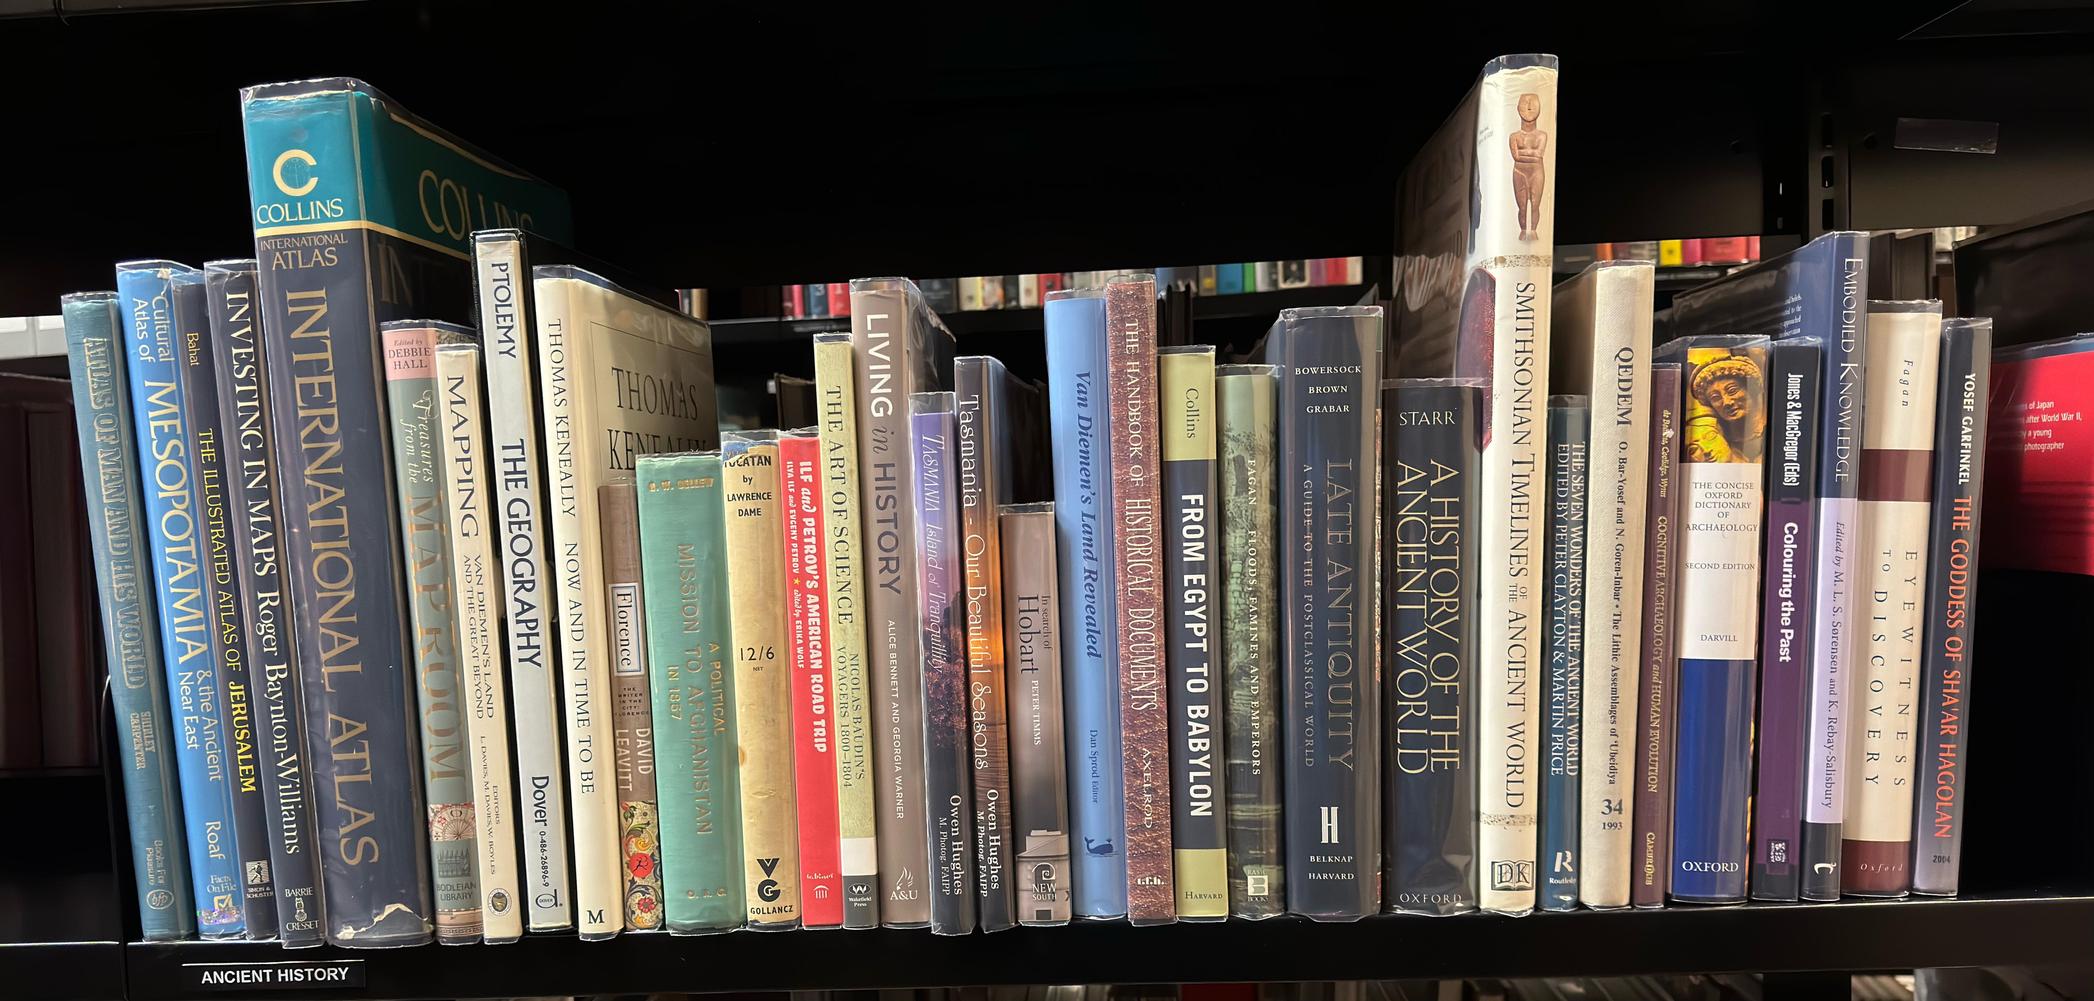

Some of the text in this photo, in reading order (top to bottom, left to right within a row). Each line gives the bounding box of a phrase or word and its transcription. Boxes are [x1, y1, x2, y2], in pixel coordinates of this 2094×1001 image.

[256, 199, 344, 225] COLLINS
[260, 233, 348, 251] INTERNATIONAL
[272, 247, 339, 270] ATLAS
[132, 298, 156, 362] Atlas of
[152, 296, 175, 362] Cultural
[491, 262, 517, 359] PTOLEMY
[187, 332, 200, 366] Bahat
[388, 346, 431, 360] DEBBIE
[394, 358, 428, 370] HALL
[1295, 366, 1361, 375] BOWERSOCK
[1835, 258, 1864, 483] EMBODIED KNOWLEDGE
[611, 366, 698, 421] THOMAS
[1308, 385, 1348, 394] BROWN
[1613, 346, 1634, 426] QEDEM
[1899, 360, 1914, 407] Fagan
[2029, 401, 2054, 410] of Japan
[1185, 387, 1200, 439] Collins
[1306, 404, 1350, 413] GRABAR
[1399, 411, 1456, 426] STARR
[1783, 373, 1803, 487] Jones & MacGregor (Eds)
[2041, 413, 2059, 422] World
[2061, 413, 2074, 421] War
[413, 390, 439, 483] Treasures
[447, 375, 479, 539] MAPPING
[866, 313, 901, 595] LIVING in HISTORY
[959, 394, 982, 509] Tasmania
[2024, 442, 2065, 453] photographer
[2033, 429, 2052, 438] young
[727, 492, 772, 502] LAWRENCE
[826, 385, 853, 625] THE ART OF SCIENCE
[1693, 481, 1754, 490] THE CONCISE
[1695, 500, 1751, 510] DICTIONARY
[1704, 491, 1743, 499] OXFORD
[144, 380, 208, 664] MESOPOTAMIA
[738, 508, 762, 517] DAME
[1074, 371, 1102, 659] Van Diemen's Land Revealed
[1125, 319, 1158, 711] THE HANDBOOK OF HISTORICAL DOCUMENTS
[1685, 523, 1758, 532] ARCHAEOLOGY
[1717, 511, 1729, 519] OF
[502, 439, 543, 668] THE GEOGRAPHY
[548, 319, 595, 794] THOMAS KENEALLY NOW AND IN TIME TO BE
[965, 533, 986, 578] Our
[1505, 282, 1536, 808] SMITHSONIAN TIMELINES OF THE ANCIENT WORLD
[226, 291, 303, 855] INVESTING IN MAPS Roger Baynton-Williams
[286, 287, 379, 866] INTERNATIONAL ATLAS
[1778, 522, 1799, 662] Colouring the Past
[199, 428, 256, 793] THE ILLUSTRATED ATLAS OF JERUSALEM
[616, 591, 633, 667] Florence
[799, 461, 827, 753] ILF and PETROV'S AMERICAN ROAD TRIP
[968, 585, 991, 674] Beautiful
[1326, 459, 1354, 771] LATE ANTIQUITY
[1396, 460, 1428, 775] ANCIENT WORLD
[1429, 459, 1460, 773] A HISTORY OF THE
[1551, 444, 1569, 776] EDITED BY PETER CLAYTON & MARTIN PRICE
[1934, 373, 1976, 839] YOSEF GARFINKEL THE GODDESS OF SHA'AR HAGOLAN
[740, 646, 775, 661] 12/6
[1017, 594, 1040, 674] Hobart
[1181, 495, 1213, 816] FROM EGYPT TO BABYLON
[1700, 634, 1738, 642] DARVILL
[971, 681, 994, 770] Seasons
[1031, 680, 1041, 745] PETER TIMMS
[616, 729, 632, 792] LEAVITT
[635, 728, 653, 775] DAVID
[532, 776, 549, 826] Dover
[1601, 798, 1623, 815] 34
[206, 820, 226, 861] Roaf
[950, 795, 964, 895] Owen Hughes
[1601, 821, 1623, 830] 1993
[1032, 883, 1056, 893] NEW
[1496, 863, 1531, 884] DK
[1682, 861, 1739, 872] OXFORD
[750, 905, 794, 915] GOLLANCZ
[890, 890, 918, 901] A&U
[1032, 893, 1056, 901] SOUTH
[1185, 891, 1223, 901] HARVARD
[1400, 893, 1461, 904] OXFORD
[201, 967, 349, 984] ANCIENT HISTORY
